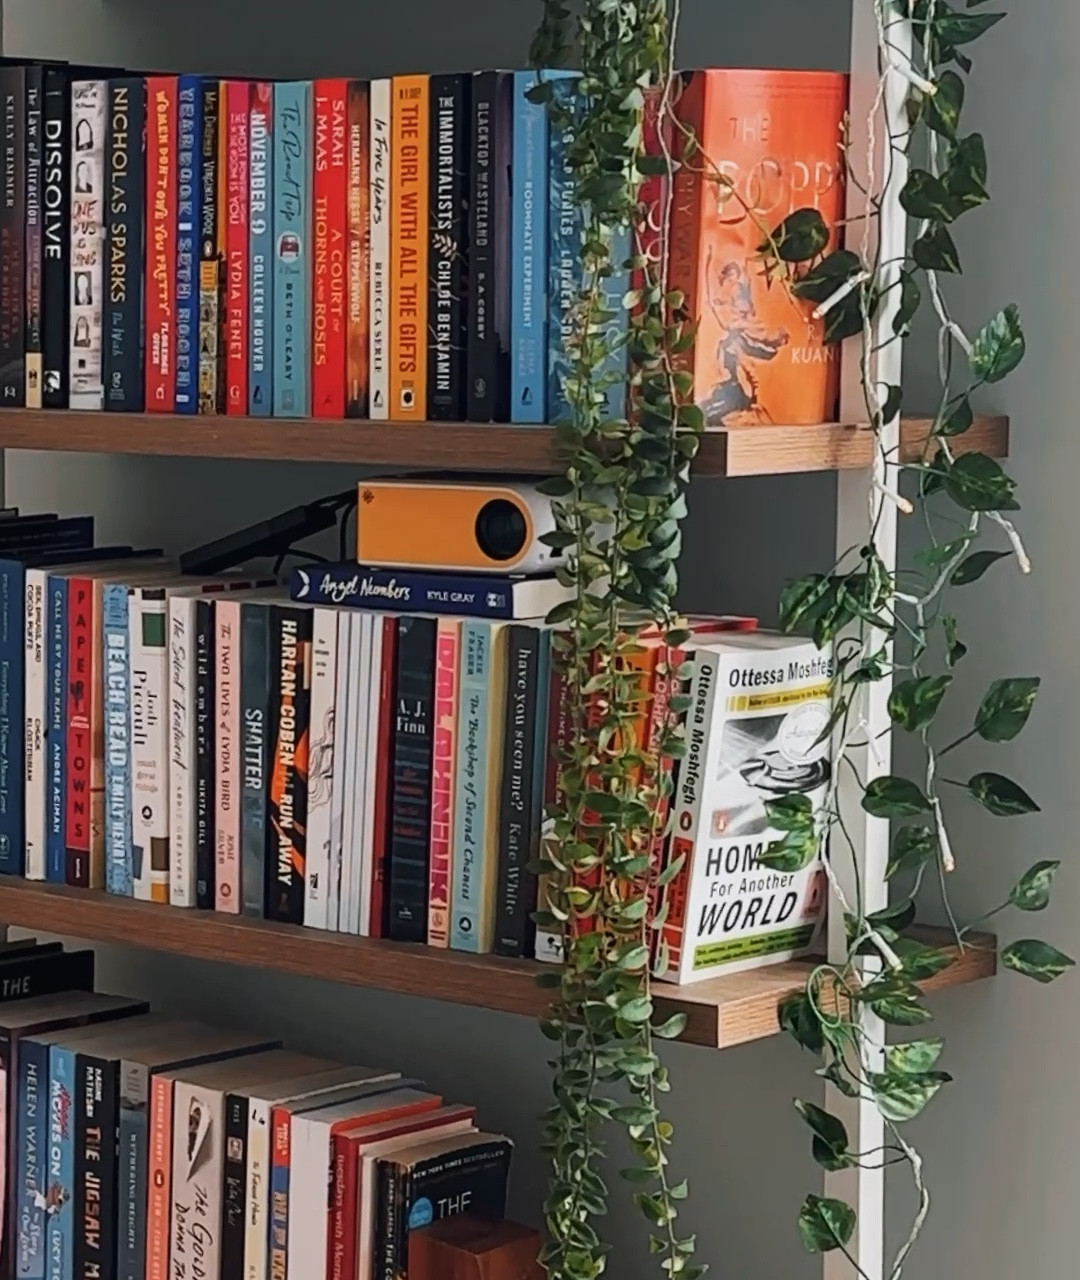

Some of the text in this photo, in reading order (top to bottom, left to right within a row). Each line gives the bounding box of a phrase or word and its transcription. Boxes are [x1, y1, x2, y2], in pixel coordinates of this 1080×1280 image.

[6, 96, 15, 207] KELLY RIMMER
[29, 111, 39, 136] Law
[316, 116, 328, 172] MAAS
[332, 100, 344, 166] SARAH
[28, 158, 40, 224] Attraction
[45, 120, 61, 259] DISSOLVE
[111, 88, 128, 303] NICHOLAS SPARKS
[251, 114, 265, 234] NOVEMBER 9
[439, 110, 453, 229] IMMORTALISTS
[315, 196, 328, 365] THORNS ROSES
[332, 229, 342, 316] A COURT
[400, 104, 418, 372] THE GIRL WITH ALL THE GIFTS
[230, 252, 242, 360] LYDIA FENET
[253, 256, 265, 371] COLLEEN HOOVER
[284, 283, 293, 380] BETH O'LEARY
[437, 261, 451, 390] CHLOE BENJAMIN
[319, 573, 411, 602] Angel Numbers
[451, 591, 475, 604] GRAY
[108, 634, 126, 766] BEACH READ
[133, 670, 148, 746] Picoult
[279, 620, 297, 765] HARLAN COBEN
[729, 668, 784, 688] Ottessa
[244, 708, 263, 789] SHATTER
[510, 649, 531, 810] have you seen me?
[682, 665, 711, 804] Ottessa Moshfegh
[112, 776, 125, 866] EMILY HENRY
[277, 794, 293, 885] RUN AWAY
[506, 823, 521, 915] Kate White
[710, 874, 795, 898] For Another
[698, 892, 798, 937] WORLD
[2, 974, 31, 997] THE
[25, 1064, 37, 1197] HELEN WARNER
[51, 1080, 62, 1176] MOVES ON
[85, 1126, 100, 1160] THE
[84, 1172, 99, 1249] JIGSAW
[335, 1155, 346, 1206] tuesdays
[335, 1211, 344, 1239] with
[175, 1203, 186, 1252] DONNA
